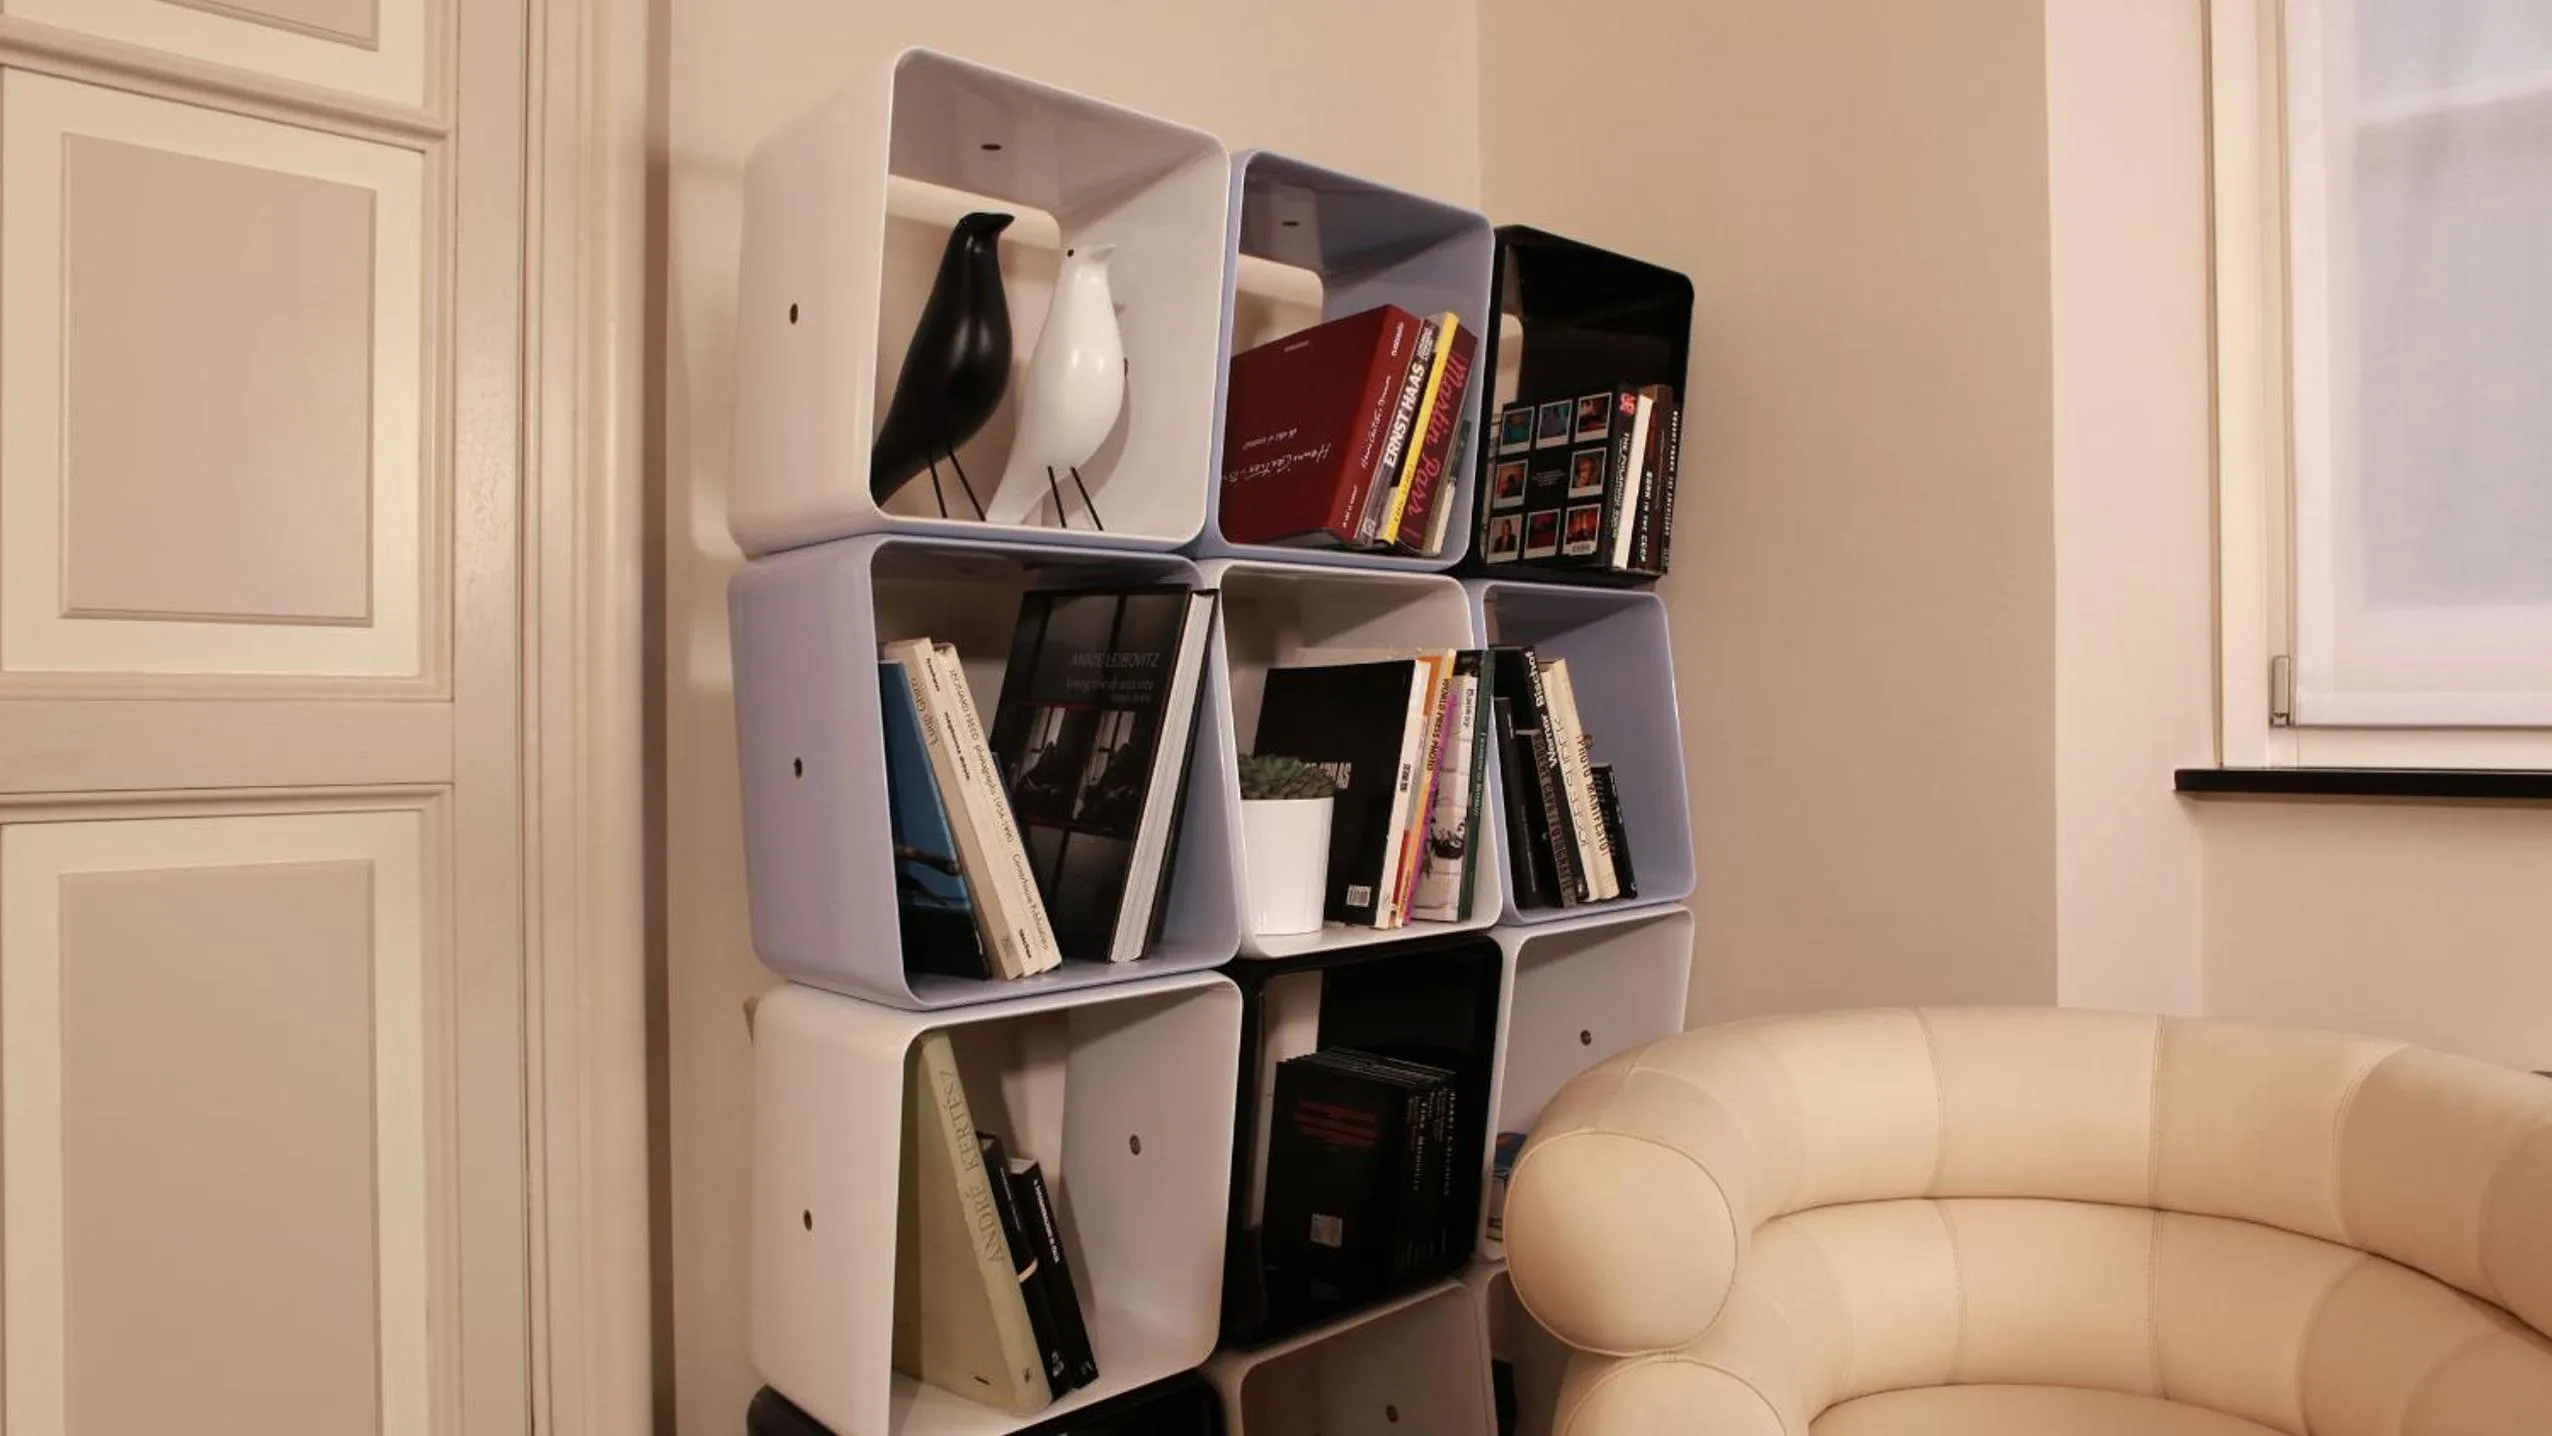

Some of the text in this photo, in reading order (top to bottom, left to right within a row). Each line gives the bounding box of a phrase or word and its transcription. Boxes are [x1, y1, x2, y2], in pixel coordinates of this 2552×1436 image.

[1383, 411, 1410, 468] ERNST
[1400, 362, 1425, 414] HAAS
[1408, 352, 1469, 516] Martin Parr
[1426, 678, 1450, 771] WORLD PRESS PHOTO
[1525, 651, 1557, 768] Werner Bischof
